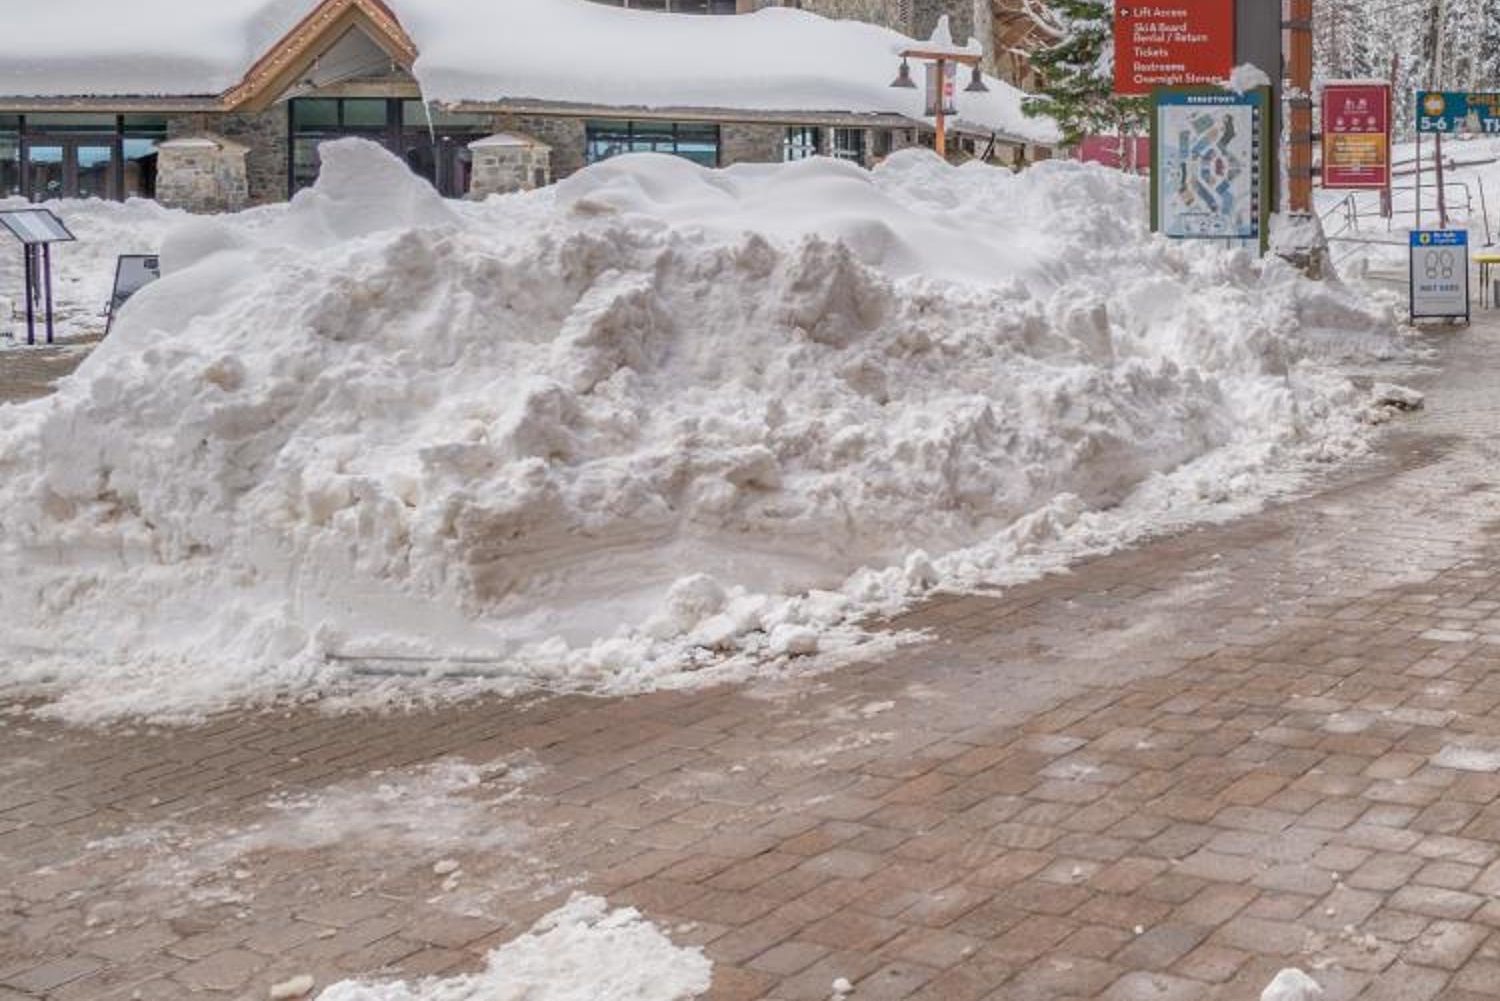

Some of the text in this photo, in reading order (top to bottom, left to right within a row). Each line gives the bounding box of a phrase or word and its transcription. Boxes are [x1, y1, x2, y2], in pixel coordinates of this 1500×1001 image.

[1133, 7, 1188, 17] Lift Access
[1133, 22, 1147, 33] Ski
[1158, 22, 1187, 33] Board
[1133, 32, 1165, 43] Rental
[1174, 33, 1209, 43] Return
[1134, 47, 1169, 58] Tickets
[1133, 62, 1185, 72] Restrooms
[1133, 74, 1183, 85] Overnight
[1420, 117, 1448, 130] 5-6
